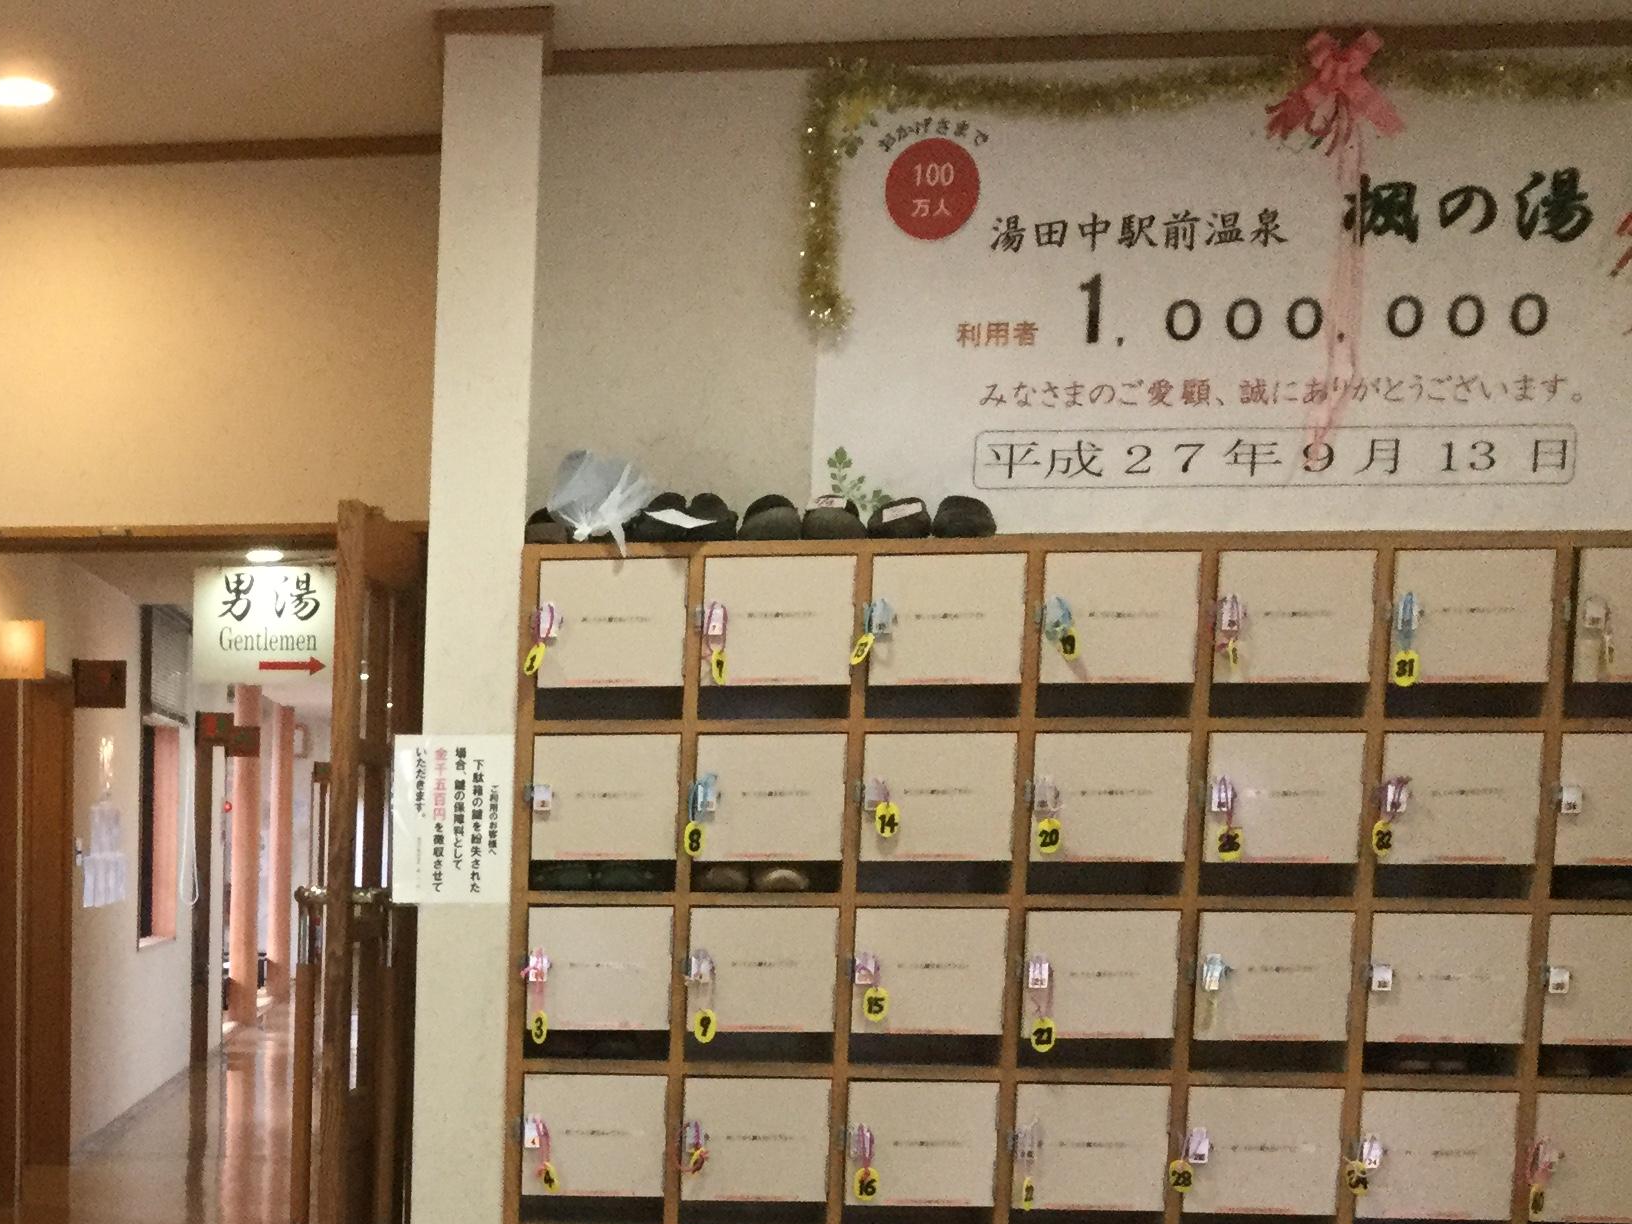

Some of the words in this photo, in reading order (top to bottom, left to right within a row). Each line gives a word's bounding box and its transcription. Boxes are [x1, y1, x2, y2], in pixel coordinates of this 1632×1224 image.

[878, 116, 990, 152] おかげさまで
[912, 161, 955, 187] 100
[911, 198, 952, 218] 万人
[989, 206, 1288, 253] 湯田中駅前温泉
[956, 320, 1039, 348] 利用者
[218, 572, 321, 622] 男湯
[218, 626, 318, 652] Gentlemen
[716, 658, 724, 678] 7
[415, 746, 427, 818] いただきます。
[488, 784, 499, 855] ご利用のお客様へ
[879, 813, 898, 834] 14
[689, 828, 701, 852] 8
[1039, 828, 1059, 848] 20
[866, 996, 885, 1015] 15
[535, 1016, 544, 1039] 3
[700, 1015, 711, 1037] 9
[544, 1169, 555, 1189] 4
[859, 1178, 877, 1197] 16
[1172, 1169, 1193, 1188] 28
